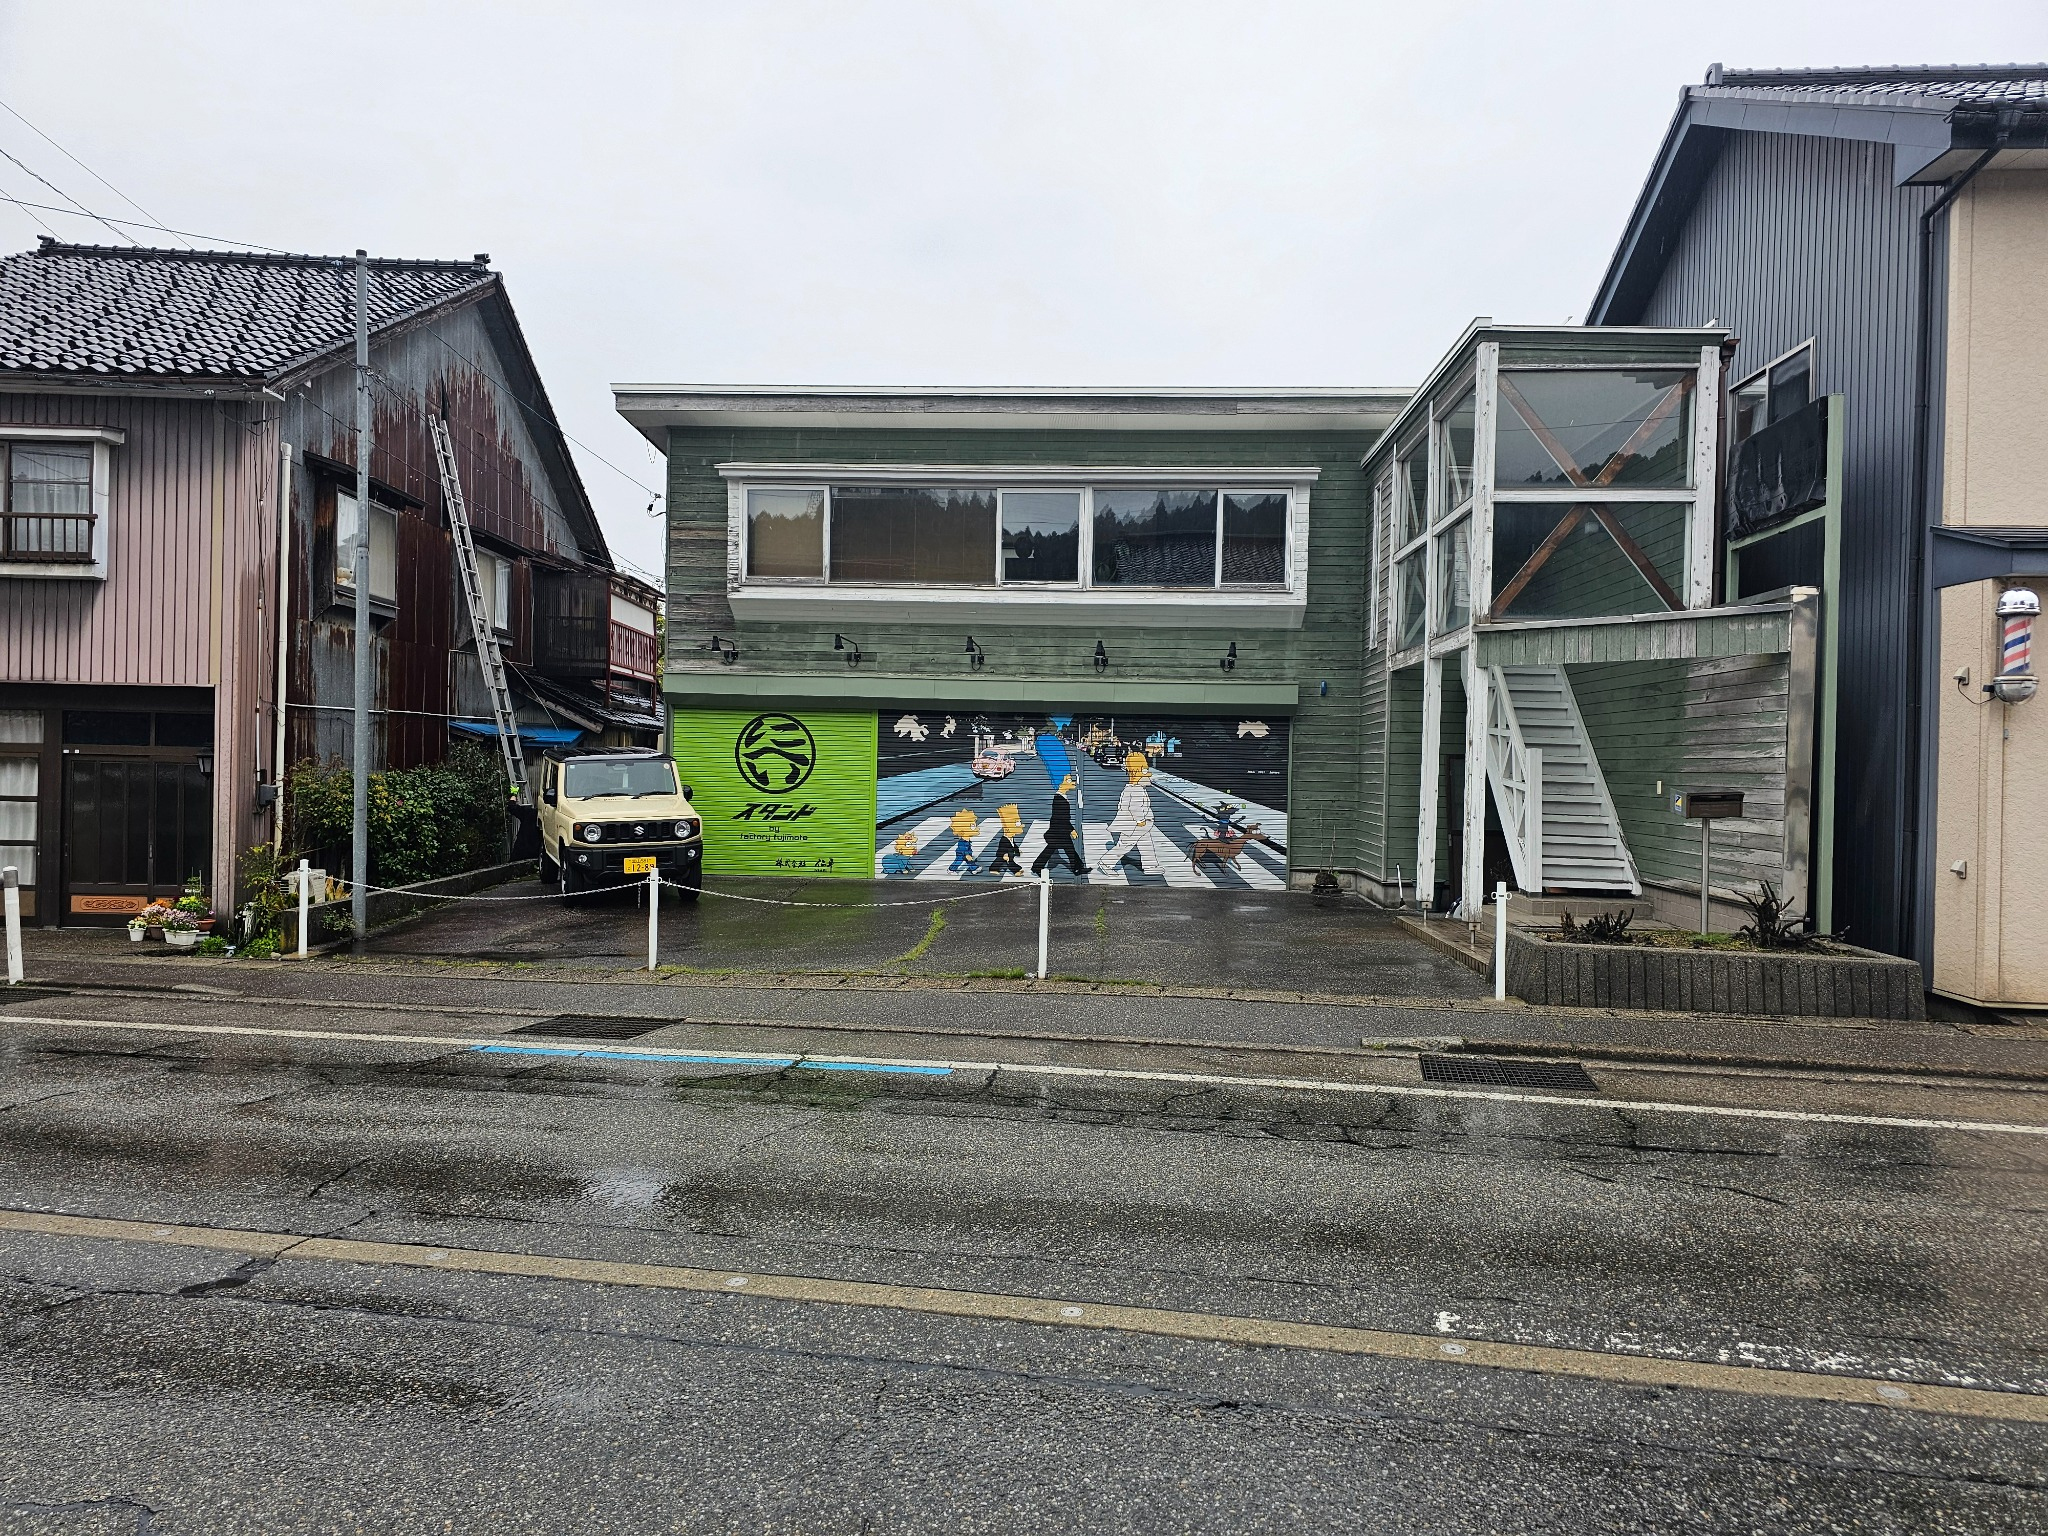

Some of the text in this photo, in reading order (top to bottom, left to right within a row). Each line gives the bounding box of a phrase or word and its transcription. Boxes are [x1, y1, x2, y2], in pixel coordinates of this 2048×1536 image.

[730, 803, 818, 821] スタンド
[740, 833, 808, 842] factory fujimoto
